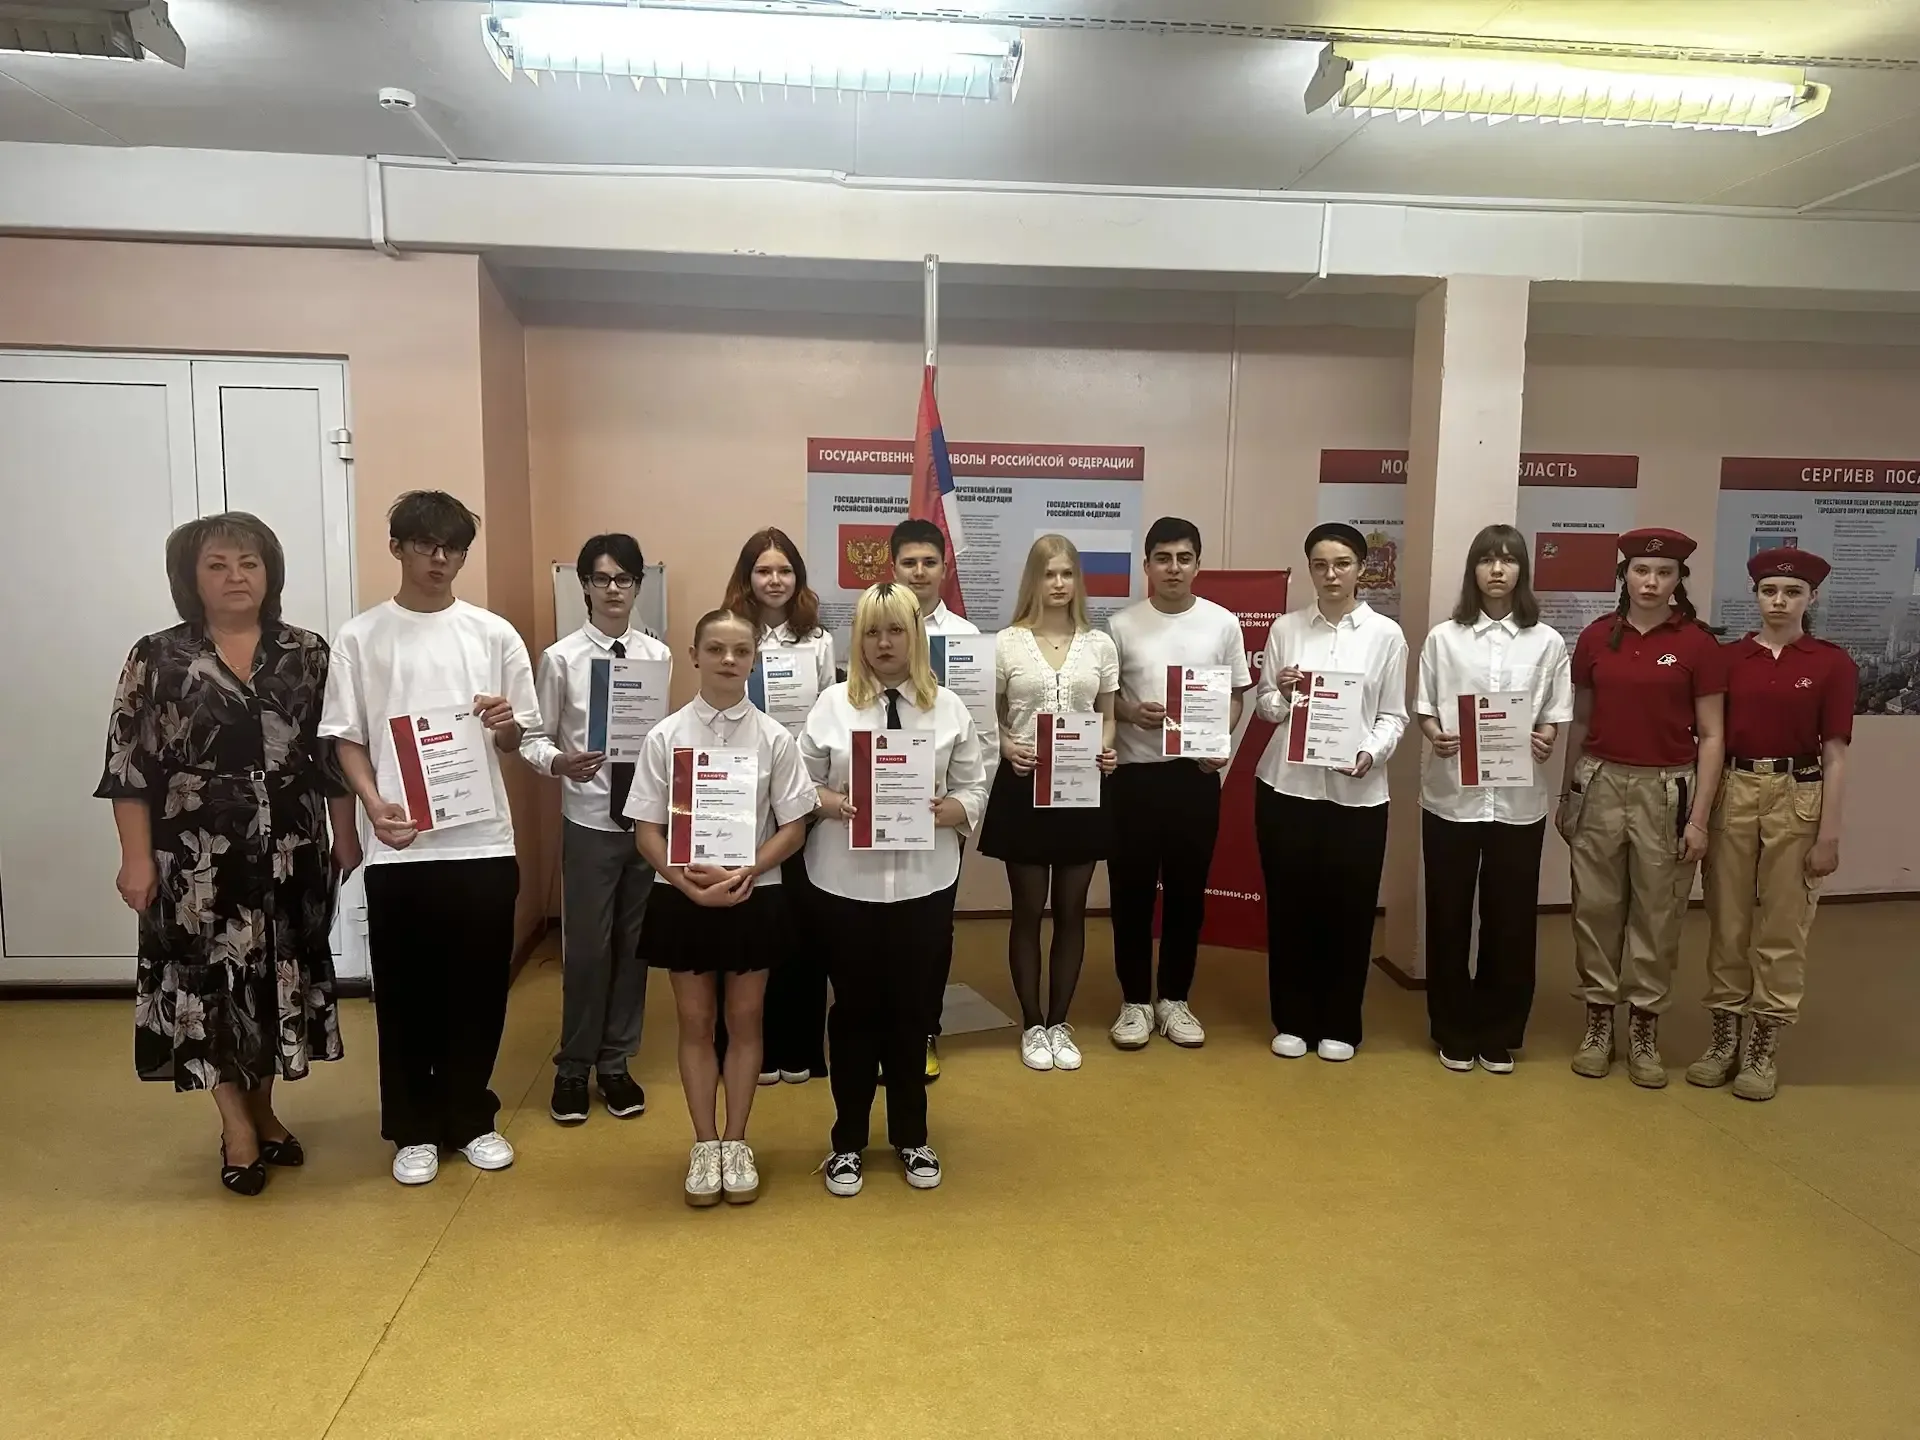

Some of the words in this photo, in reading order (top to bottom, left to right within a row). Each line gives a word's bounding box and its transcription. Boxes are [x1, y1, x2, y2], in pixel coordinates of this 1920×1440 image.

[990, 453, 1064, 467] РОССИЙСКОЙ
[1068, 455, 1134, 470] ФЕДЕРАЦИИ
[1801, 467, 1874, 483] СЕРГИЕВ
[834, 495, 893, 504] ГОСУДАРСТВЕННЫЙ
[895, 496, 908, 504] ГЕРБ
[833, 504, 873, 512] РОССИЙСКОЙ
[1046, 500, 1104, 509] ГОСУДАРСТВЕННЫЙ
[1046, 508, 1085, 517] РОССИЙСКОЙ
[1086, 510, 1121, 518] ФЕДЕРАЦИИ
[423, 734, 450, 743] ГРАМОТА
